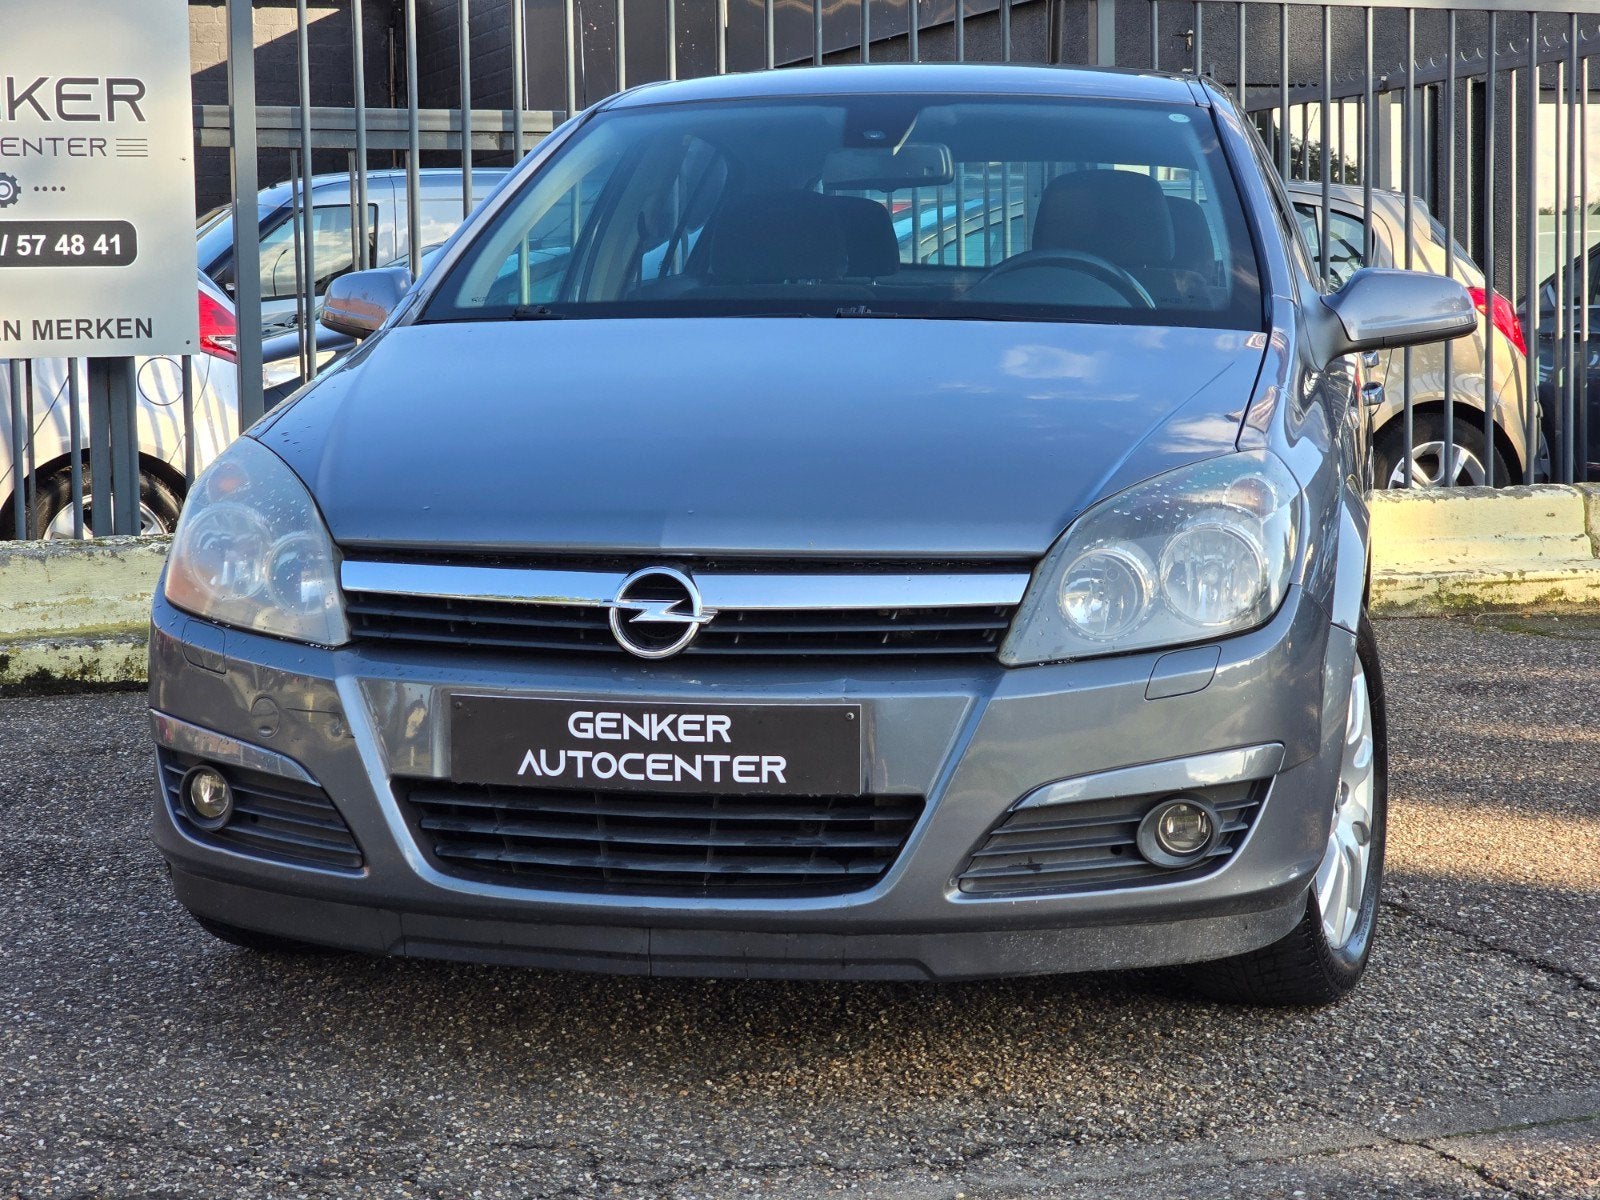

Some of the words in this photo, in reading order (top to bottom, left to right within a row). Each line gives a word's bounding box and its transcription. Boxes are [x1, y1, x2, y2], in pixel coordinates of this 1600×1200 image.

[6, 76, 147, 122] KER
[0, 136, 108, 157] ENTER
[16, 233, 47, 256] 57
[54, 233, 86, 256] 48
[93, 233, 121, 255] 41
[0, 319, 21, 341] N
[32, 317, 153, 341] MERKEN
[567, 710, 732, 743] GENKER
[517, 748, 787, 784] AUTOCENTER
